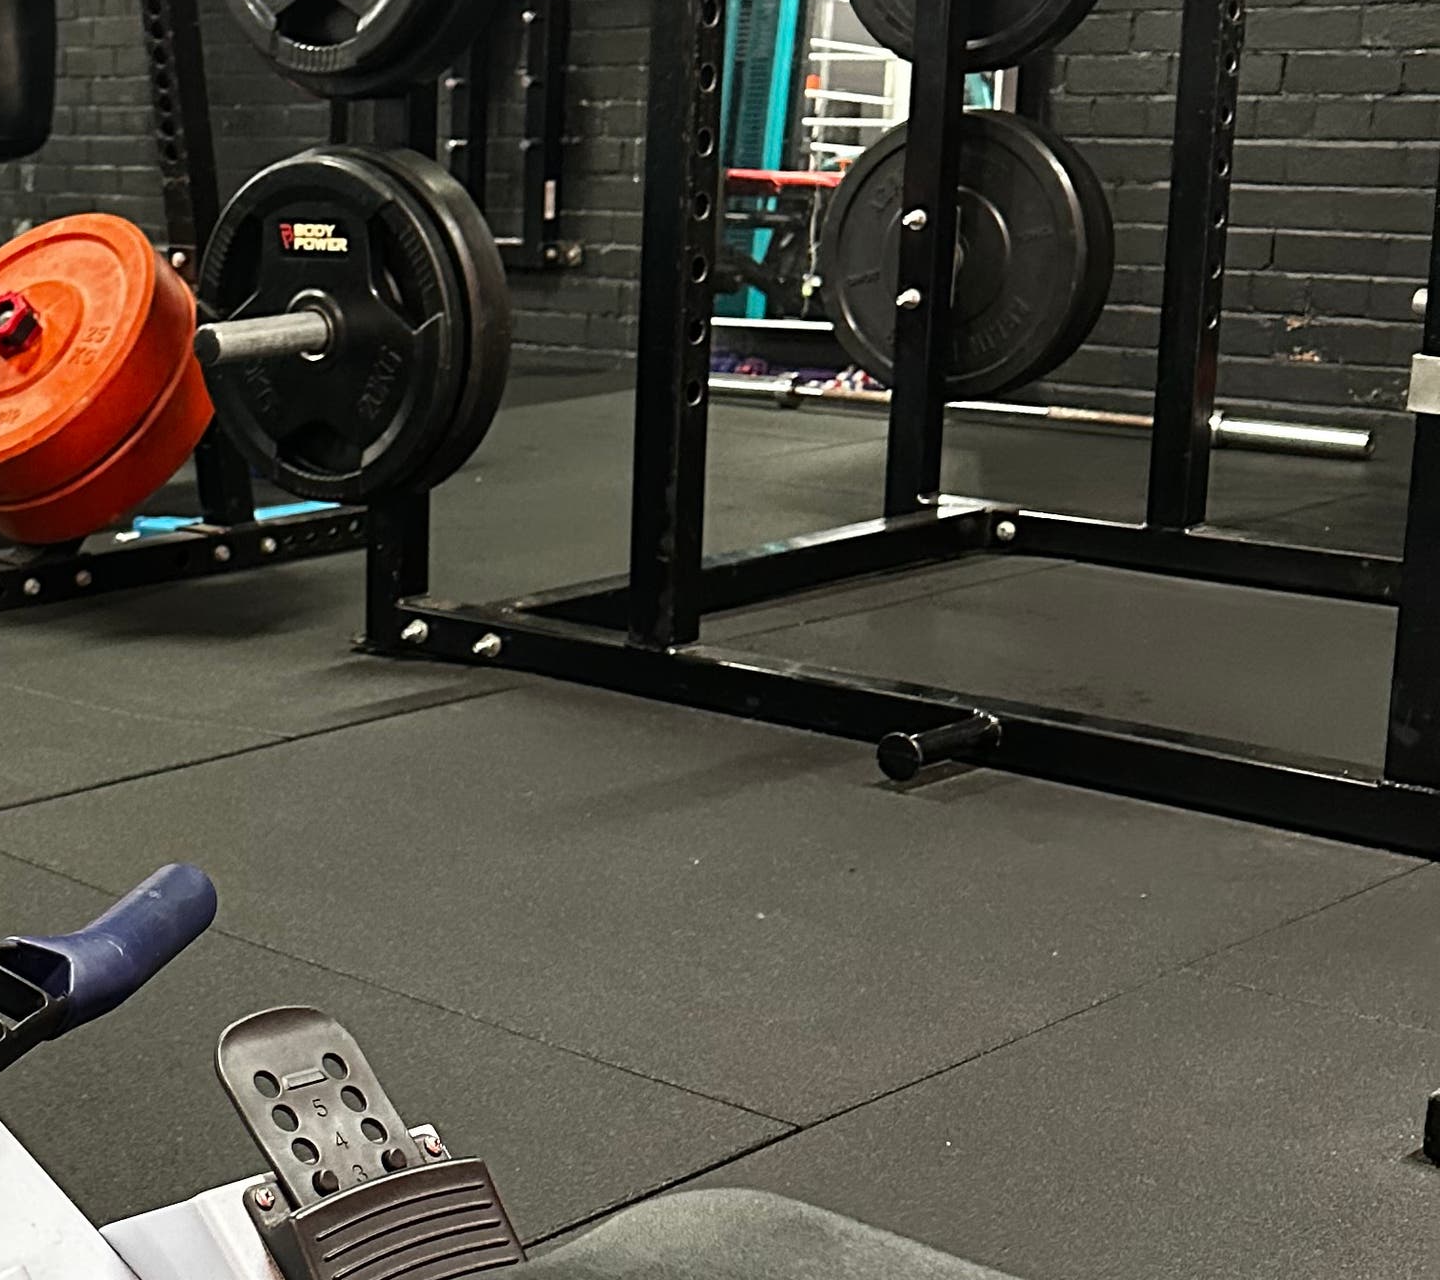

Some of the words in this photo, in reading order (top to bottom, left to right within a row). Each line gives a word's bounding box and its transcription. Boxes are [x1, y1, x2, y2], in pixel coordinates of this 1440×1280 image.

[293, 223, 336, 237] BODY
[293, 237, 348, 252] POWER
[81, 325, 111, 343] 25
[312, 1098, 328, 1118] 5
[335, 1131, 349, 1150] 4
